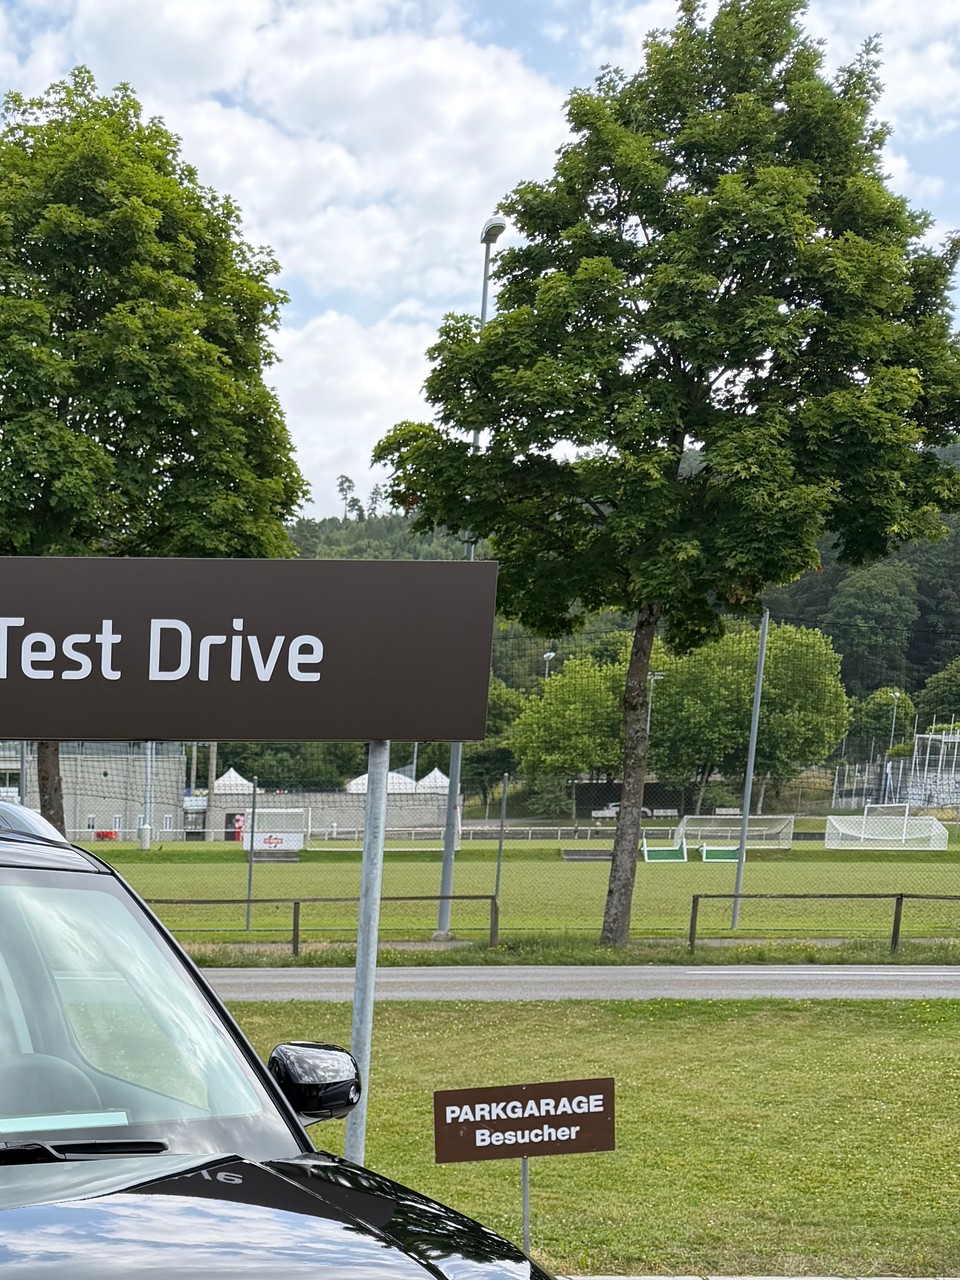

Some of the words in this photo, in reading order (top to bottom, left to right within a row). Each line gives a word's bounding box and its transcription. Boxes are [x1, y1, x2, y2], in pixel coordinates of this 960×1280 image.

[148, 618, 324, 682] Drive
[445, 1094, 604, 1124] PARKGARAGE
[475, 1124, 581, 1147] Besucher
